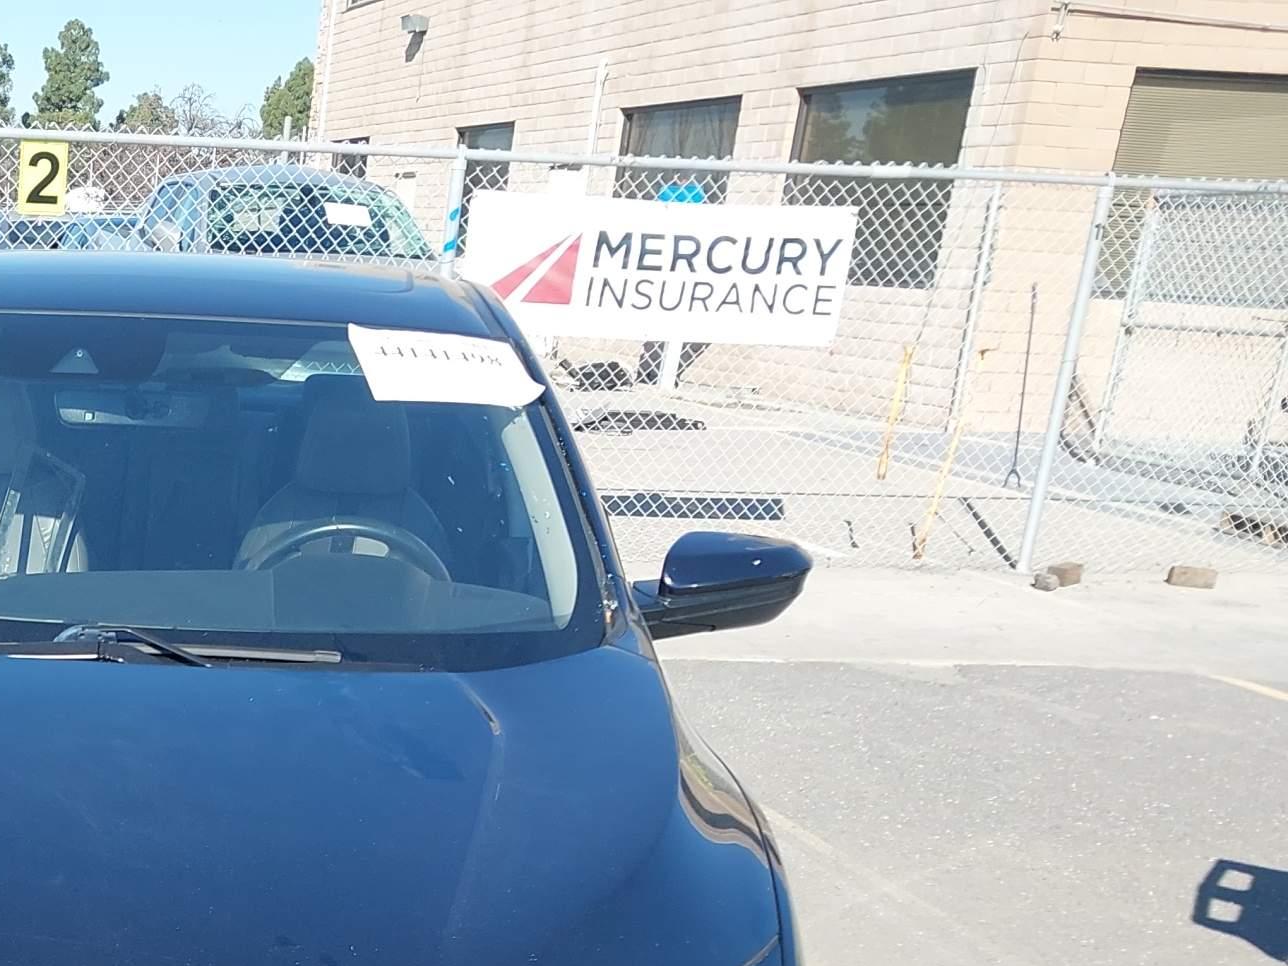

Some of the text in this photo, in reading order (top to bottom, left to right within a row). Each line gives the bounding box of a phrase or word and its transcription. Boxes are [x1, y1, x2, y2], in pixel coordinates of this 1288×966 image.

[26, 151, 59, 204] 2
[592, 230, 843, 276] MERCURY
[585, 276, 837, 316] INSURANCE
